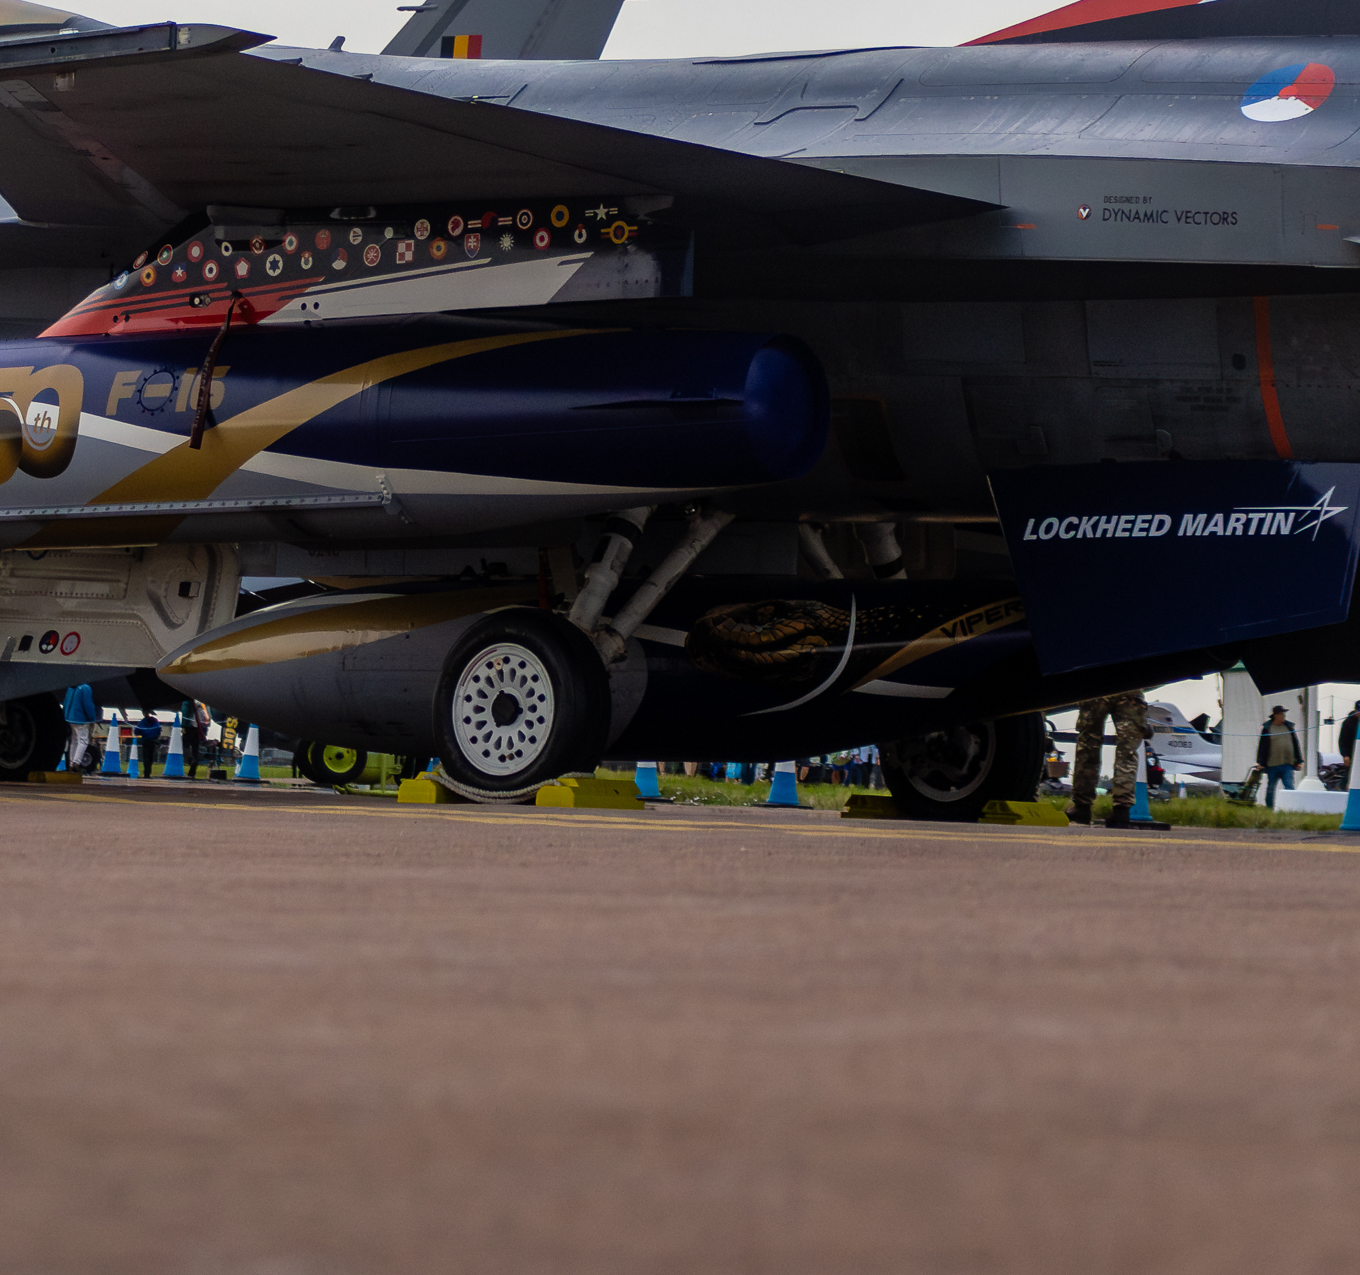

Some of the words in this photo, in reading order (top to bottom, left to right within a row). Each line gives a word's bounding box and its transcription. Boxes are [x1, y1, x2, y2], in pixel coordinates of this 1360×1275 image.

[1103, 195, 1140, 204] DESIGNED
[1142, 196, 1153, 205] BY
[1102, 207, 1169, 224] DYNAMIC
[1173, 209, 1239, 226] VECTORS
[106, 365, 231, 416] F-16
[33, 410, 53, 435] th
[1023, 514, 1172, 541] LOCKHEED
[1177, 511, 1296, 537] MARTIN
[939, 600, 1024, 638] VIPER
